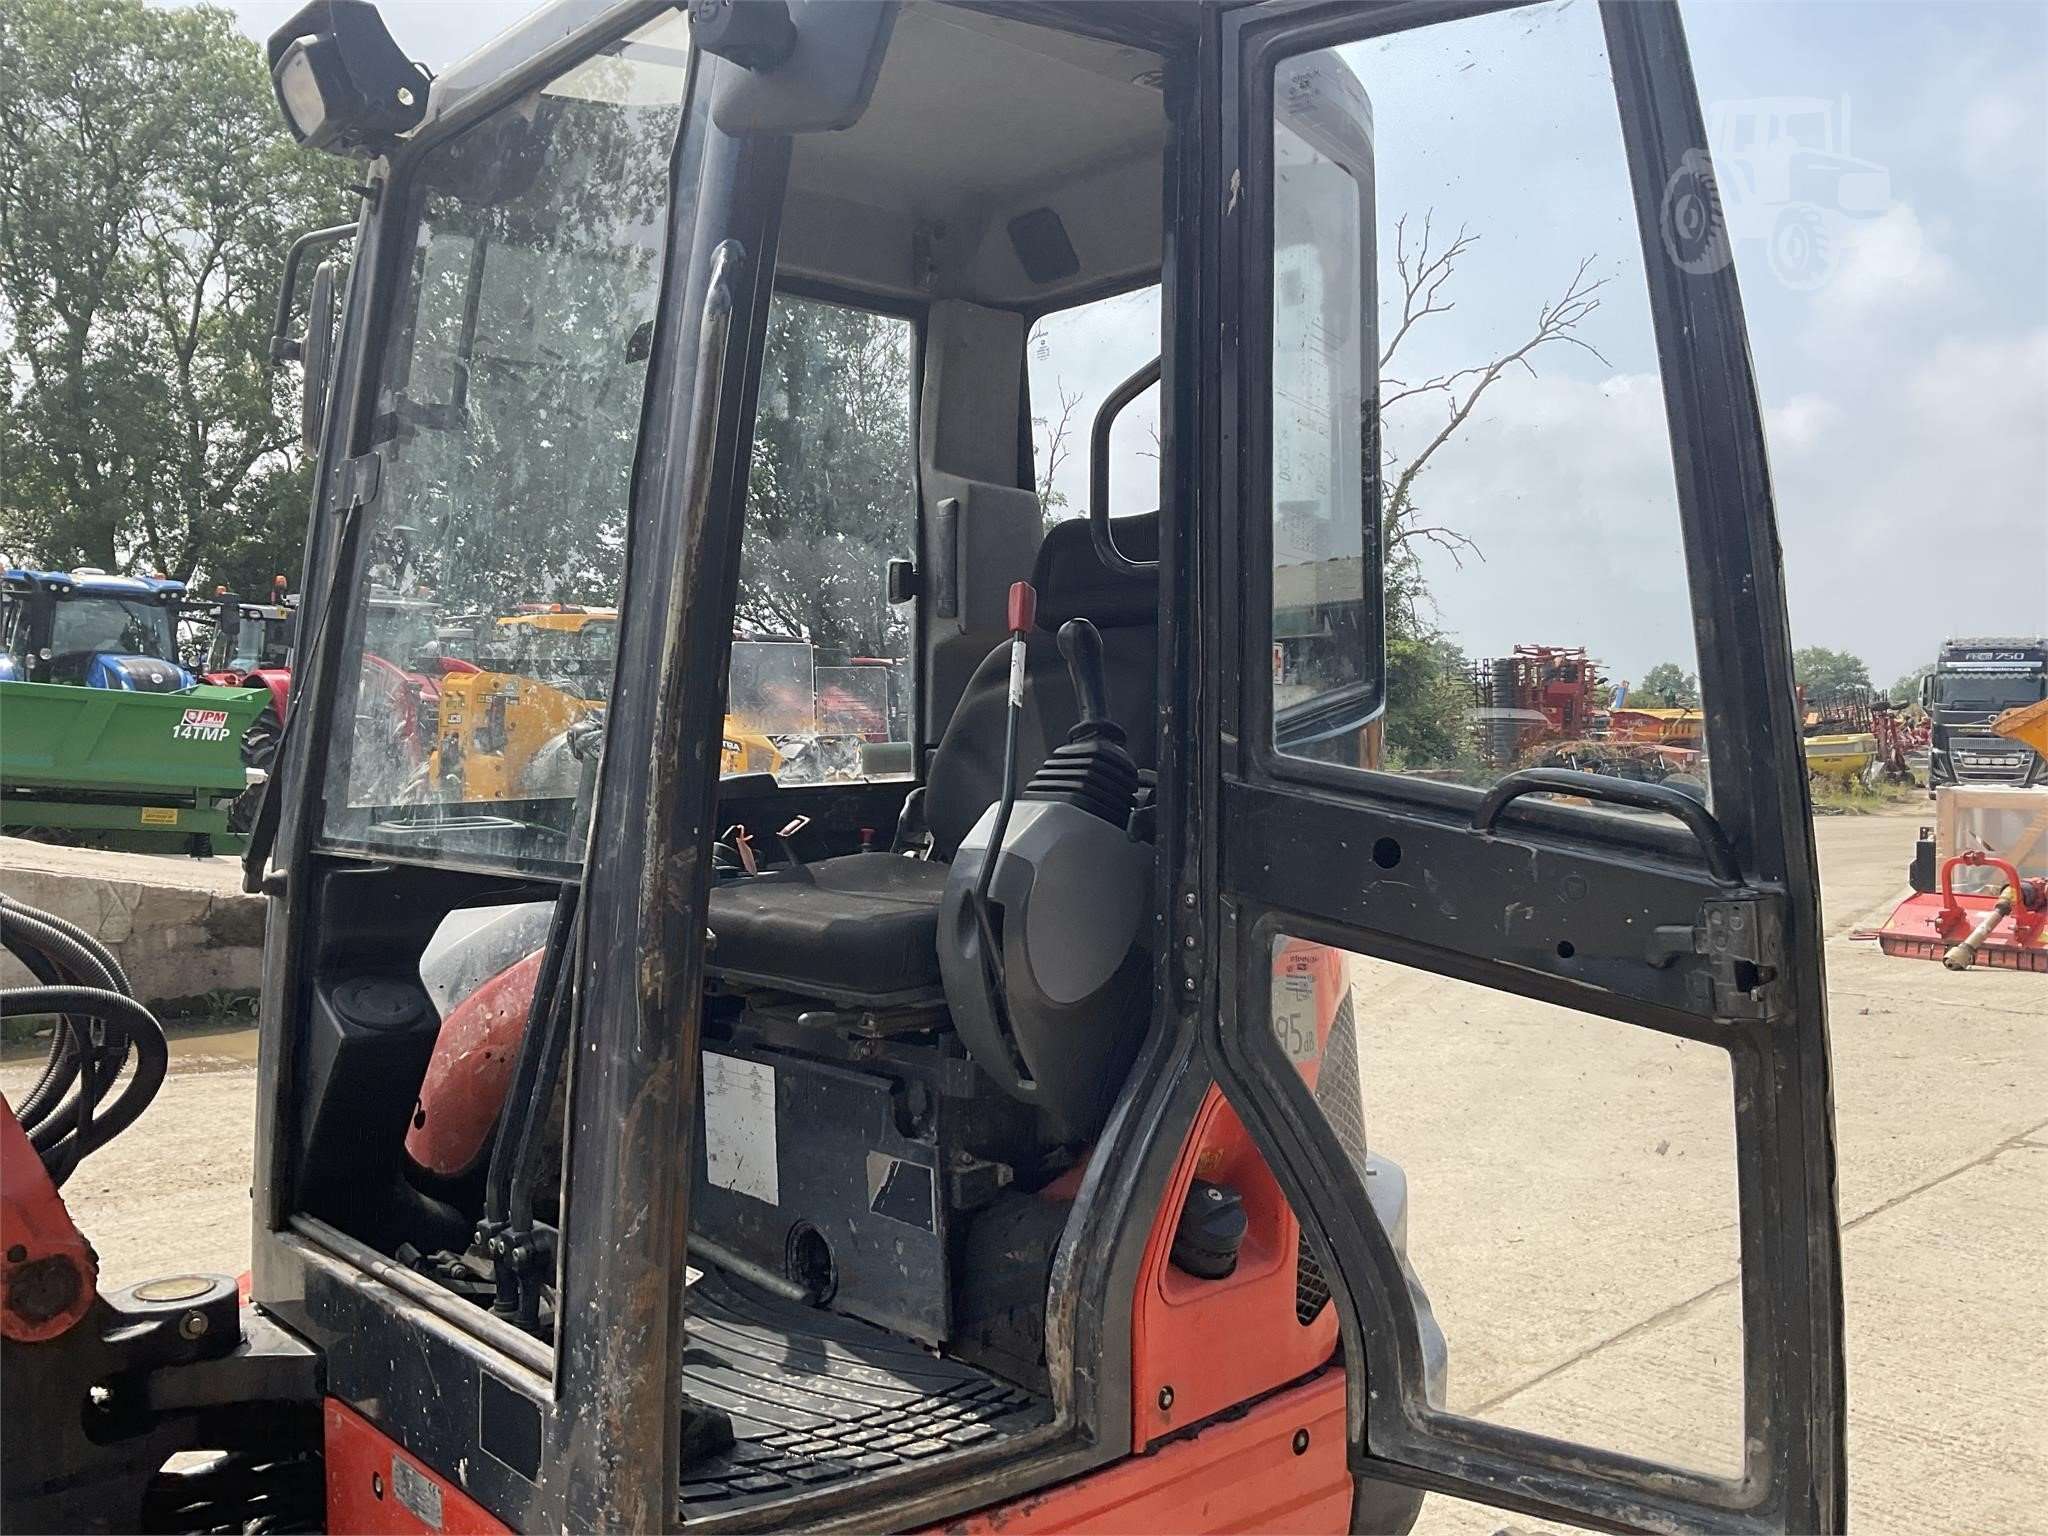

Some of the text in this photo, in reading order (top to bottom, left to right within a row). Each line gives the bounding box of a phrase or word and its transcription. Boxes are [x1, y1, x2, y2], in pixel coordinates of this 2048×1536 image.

[1995, 652, 2025, 661] 750
[197, 710, 226, 723] JPM
[173, 725, 231, 741] 14TMP
[722, 740, 741, 752] TRA
[1276, 1013, 1302, 1056] 95
